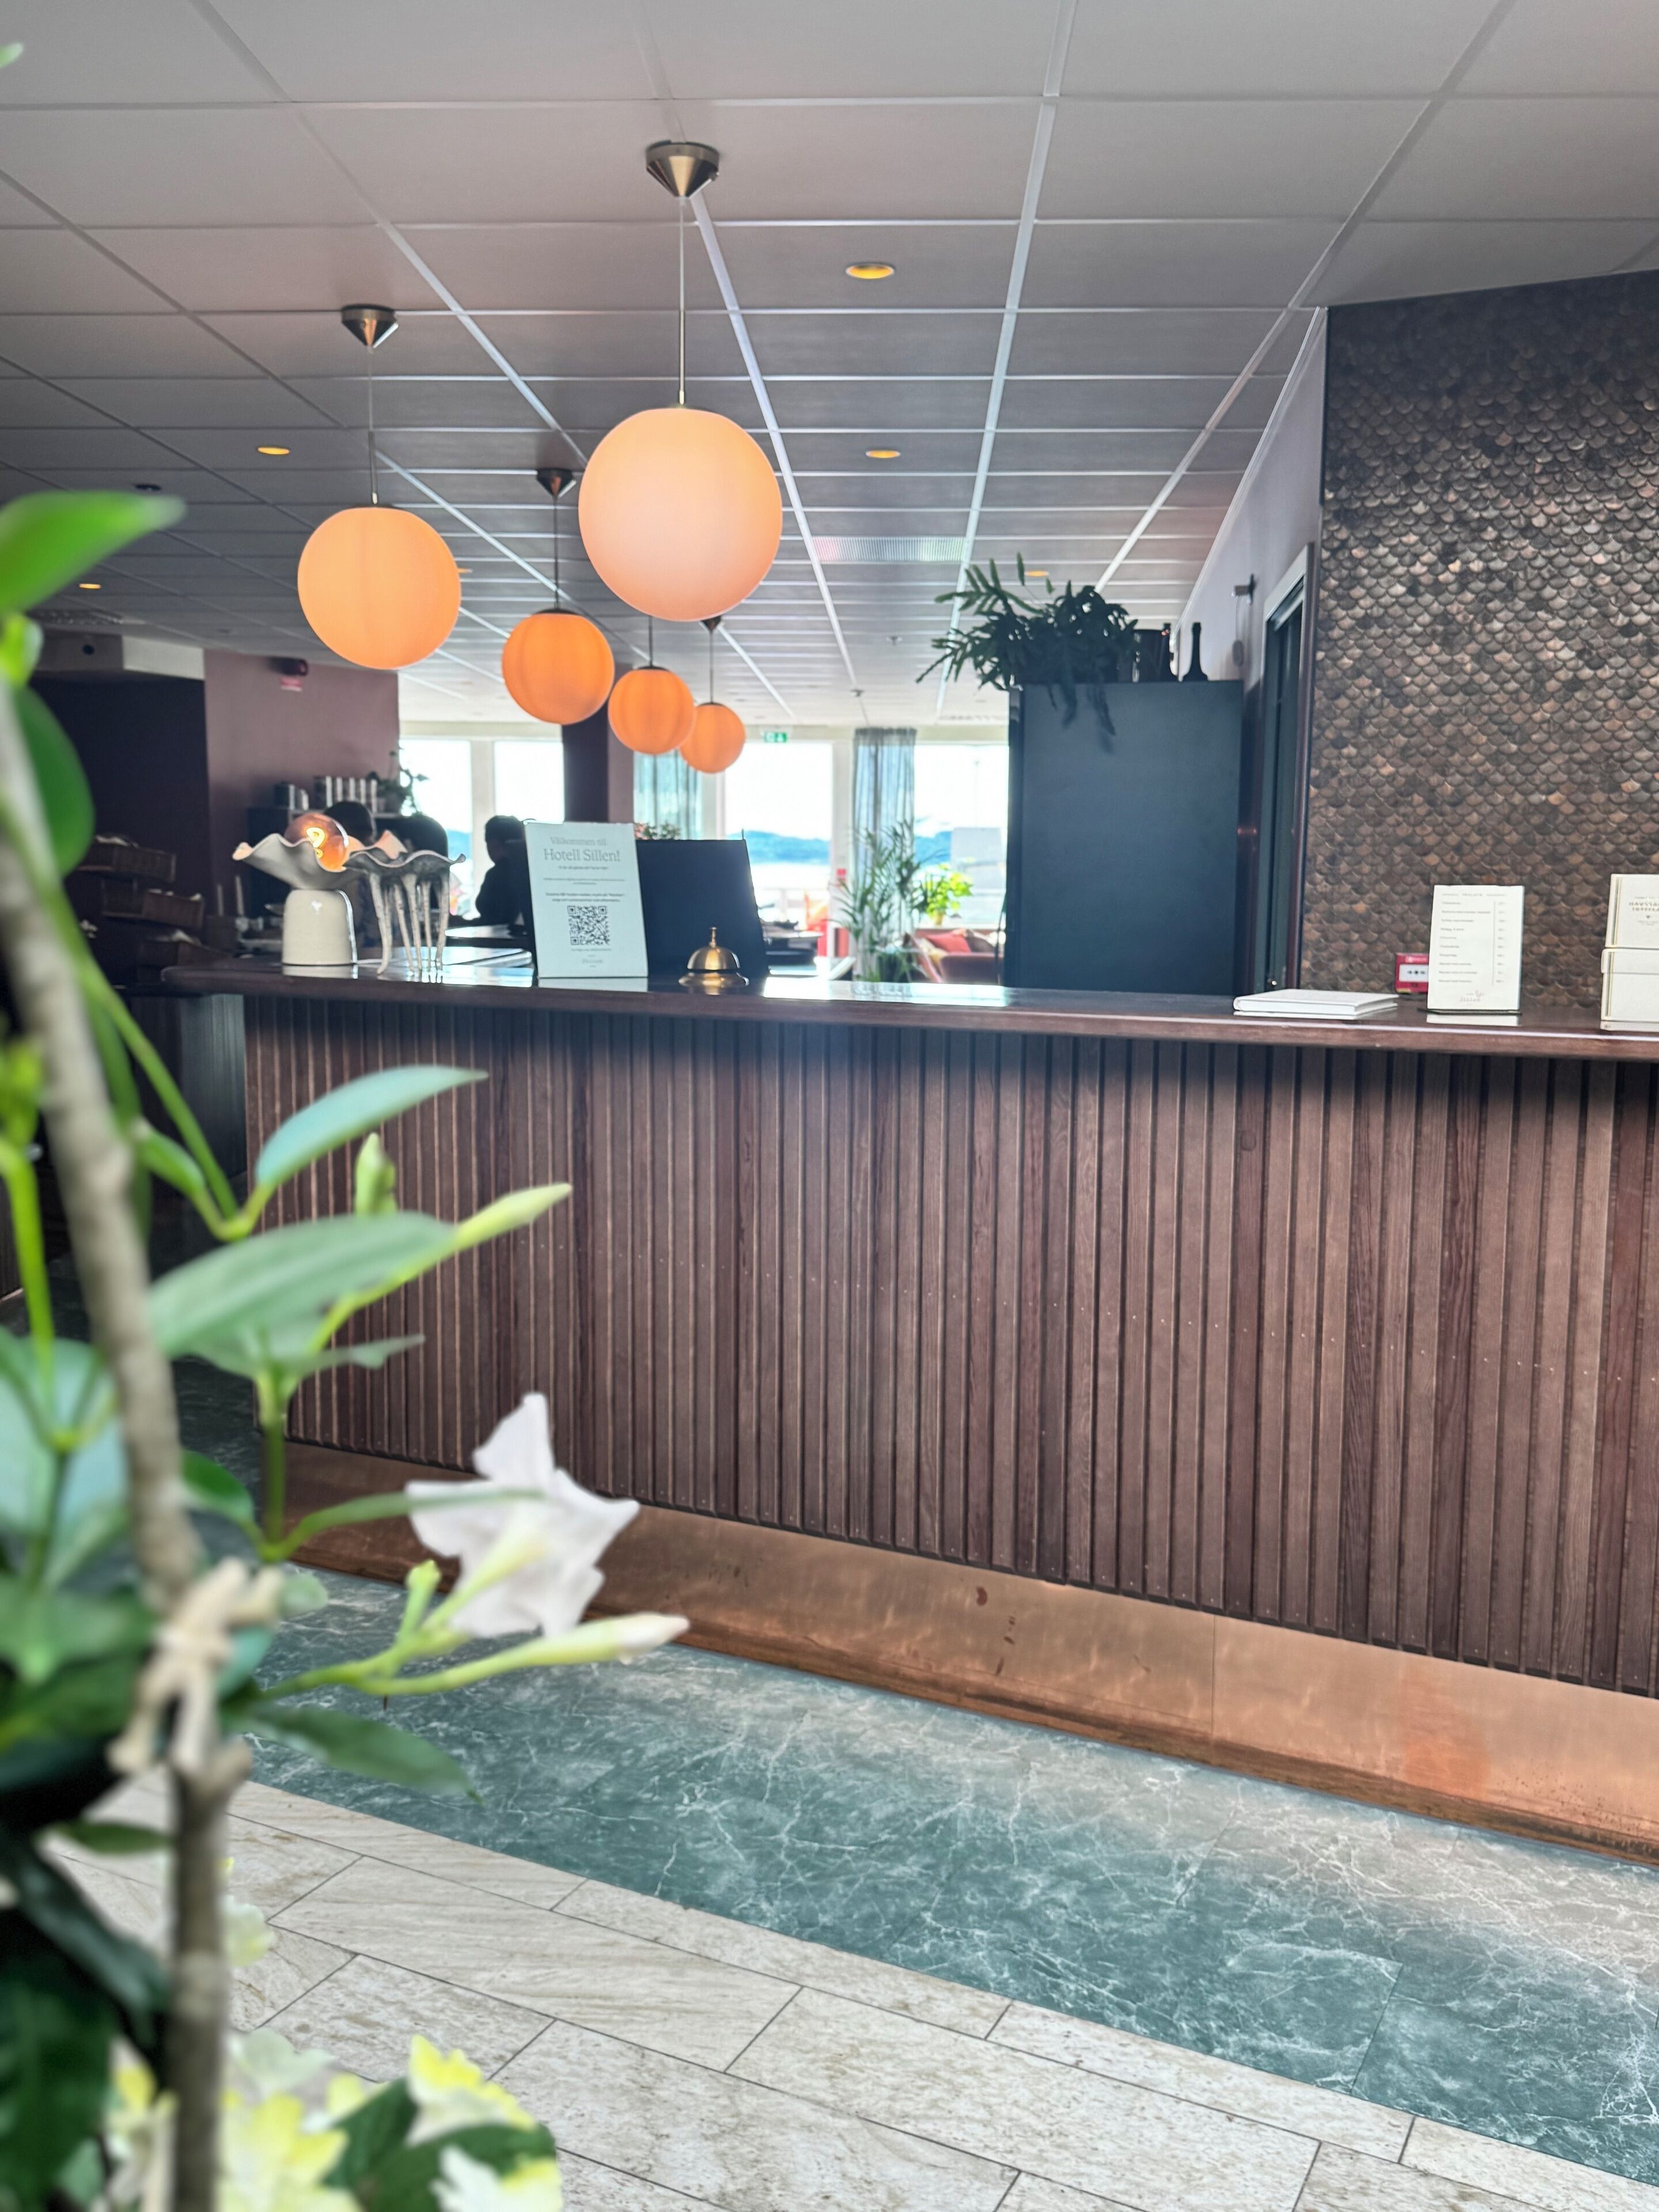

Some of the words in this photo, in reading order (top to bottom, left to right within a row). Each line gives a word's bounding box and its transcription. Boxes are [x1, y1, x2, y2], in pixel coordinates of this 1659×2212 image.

[596, 838, 607, 846] till
[544, 849, 581, 861] Hotell
[583, 849, 621, 862] Sillen!
